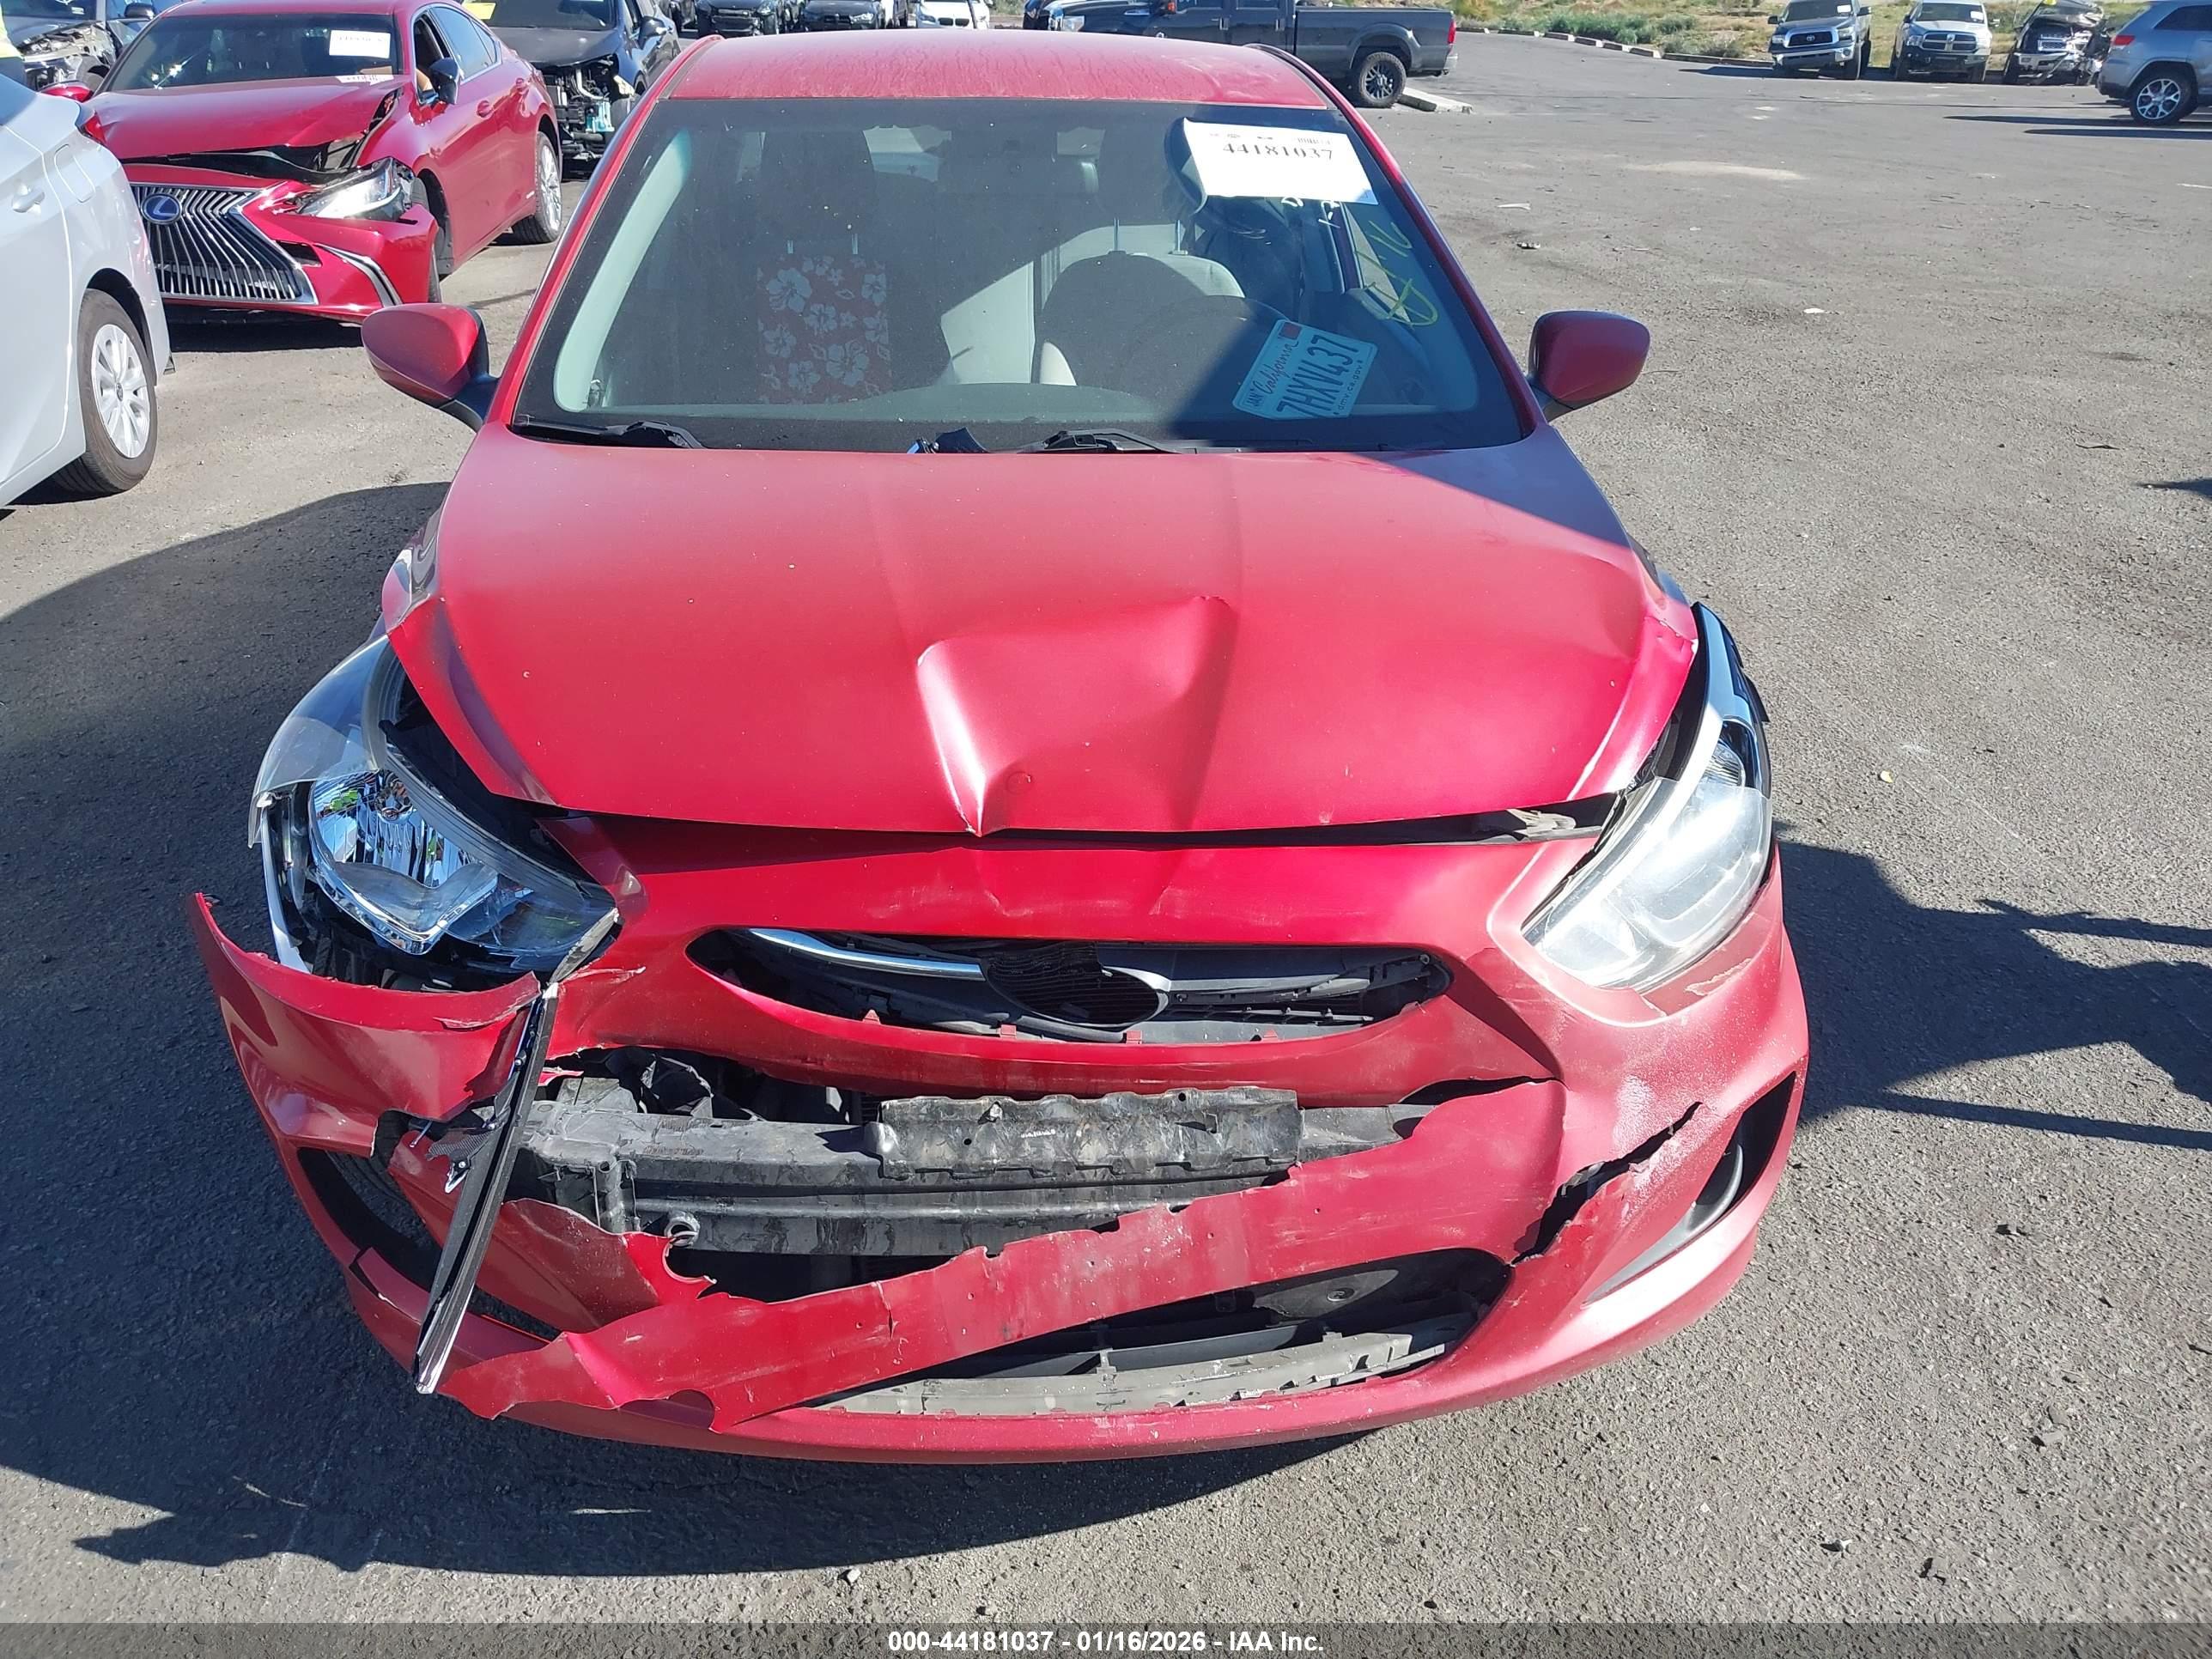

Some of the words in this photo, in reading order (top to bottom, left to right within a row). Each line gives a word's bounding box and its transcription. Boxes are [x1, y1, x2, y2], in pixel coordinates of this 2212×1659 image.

[1223, 142, 1333, 161] 44181037
[1253, 342, 1299, 394] California
[1276, 335, 1359, 418] 7HXV437
